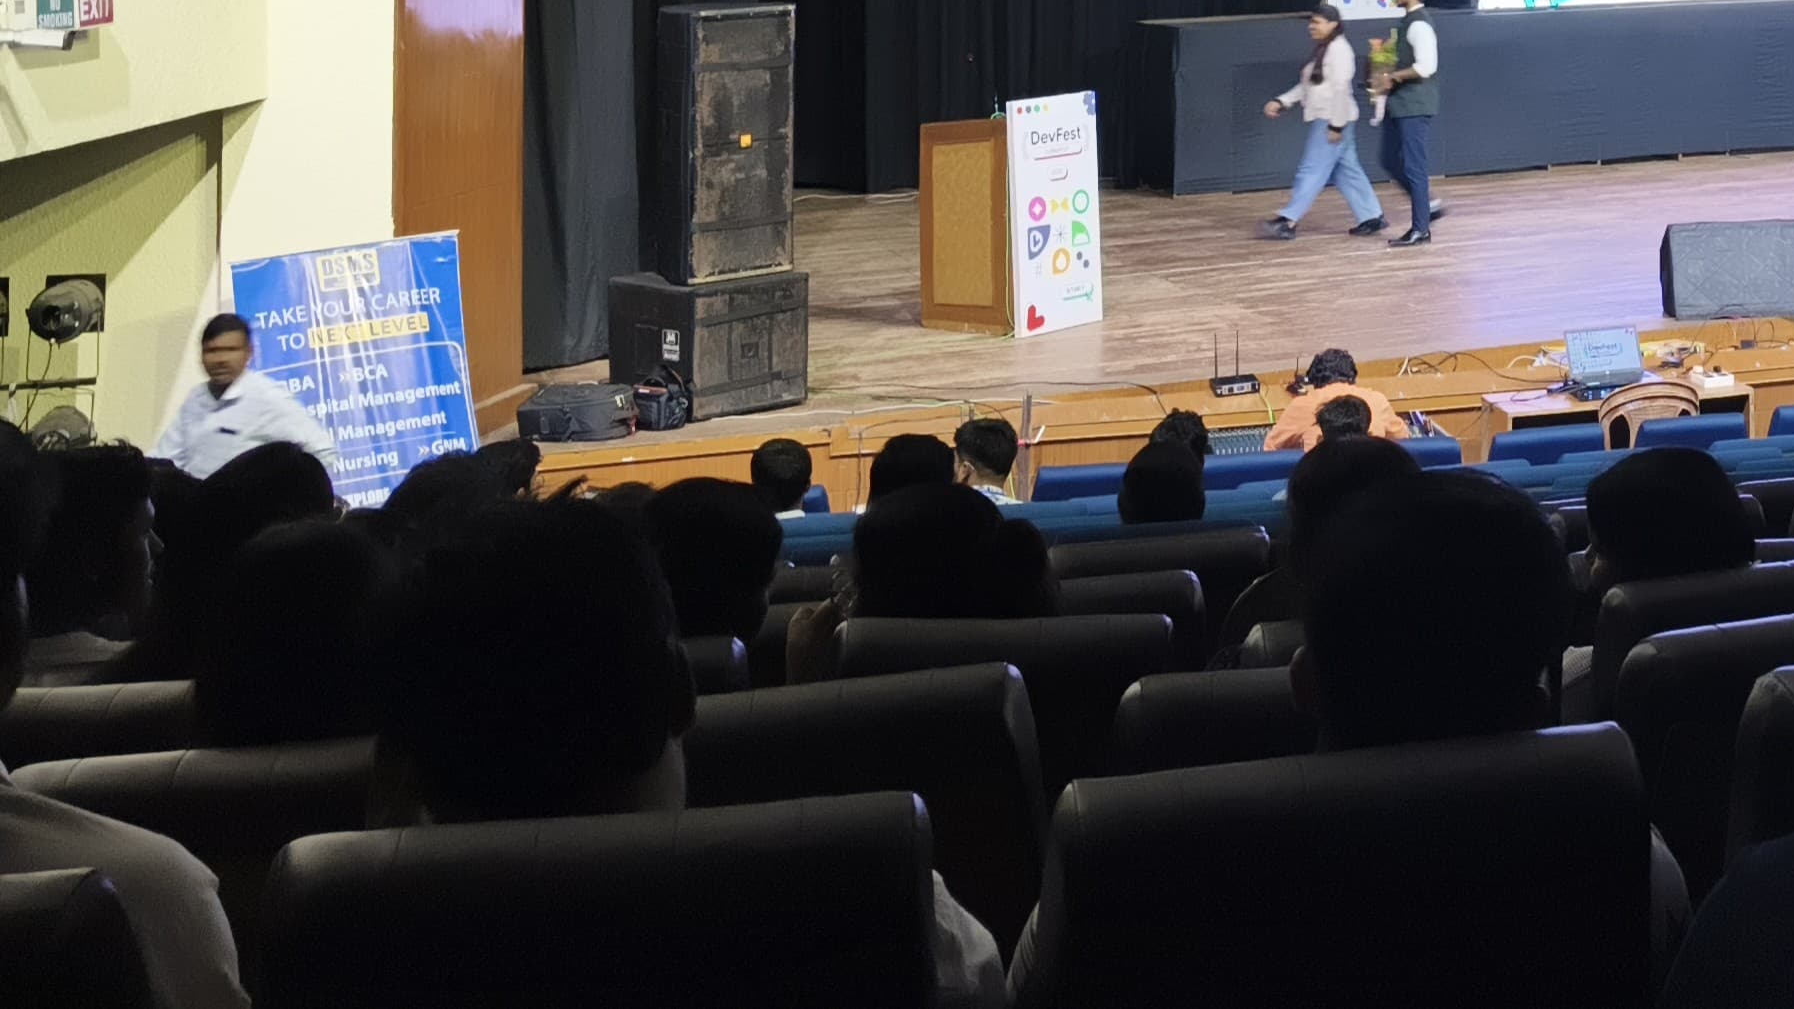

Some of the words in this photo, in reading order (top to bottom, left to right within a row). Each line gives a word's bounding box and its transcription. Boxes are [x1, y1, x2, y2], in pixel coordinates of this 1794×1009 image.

[38, 12, 73, 28] SMOKING
[1030, 126, 1081, 145] DevFest
[255, 305, 308, 329] TAKE
[310, 296, 366, 319] YOUR
[371, 287, 441, 311] CAREER
[277, 333, 305, 352] TO
[311, 323, 364, 343] NE
[369, 315, 429, 336] LEVEL
[279, 375, 315, 392] BA
[352, 364, 389, 382] BCA
[305, 394, 354, 418] spital
[358, 381, 461, 408] Management
[339, 412, 447, 441] Management
[333, 451, 399, 473] Nursing
